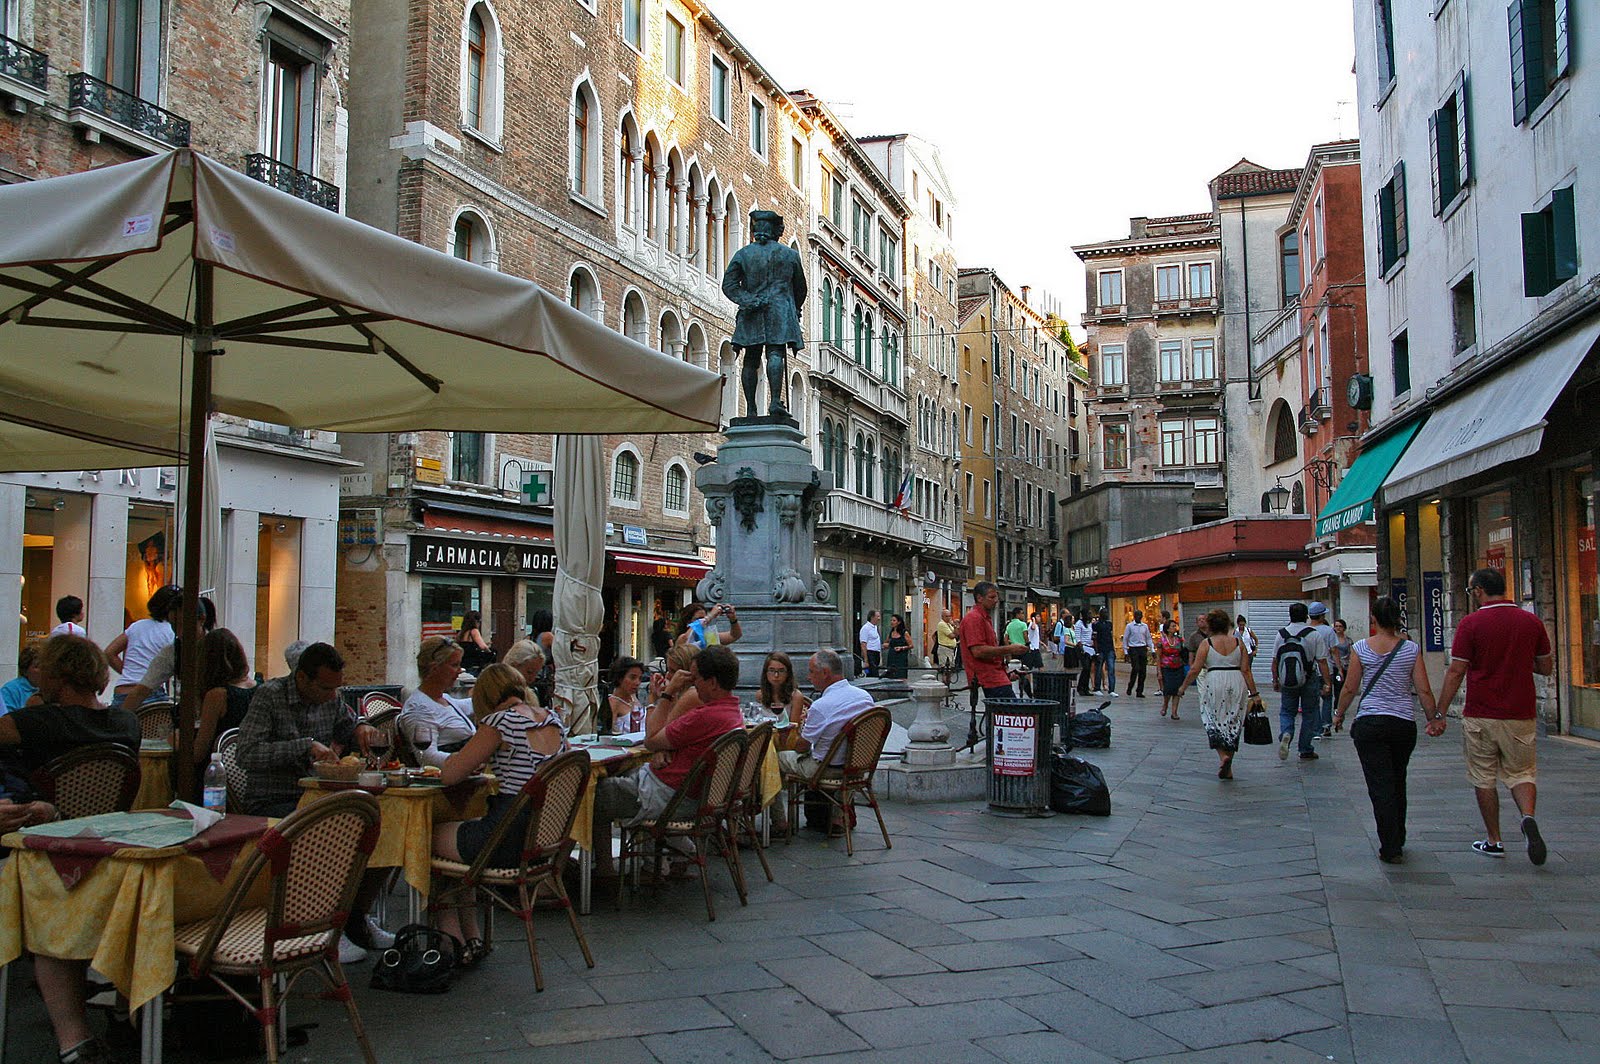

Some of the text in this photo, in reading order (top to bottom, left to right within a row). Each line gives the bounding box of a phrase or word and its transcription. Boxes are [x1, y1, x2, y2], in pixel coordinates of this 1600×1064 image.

[1578, 538, 1597, 552] SAL
[426, 544, 558, 570] FARMACIA MORE
[1070, 566, 1099, 580] FABRIS
[1398, 592, 1408, 635] CHANG
[1431, 588, 1442, 645] CHANGE
[994, 714, 1035, 727] VIETATO
